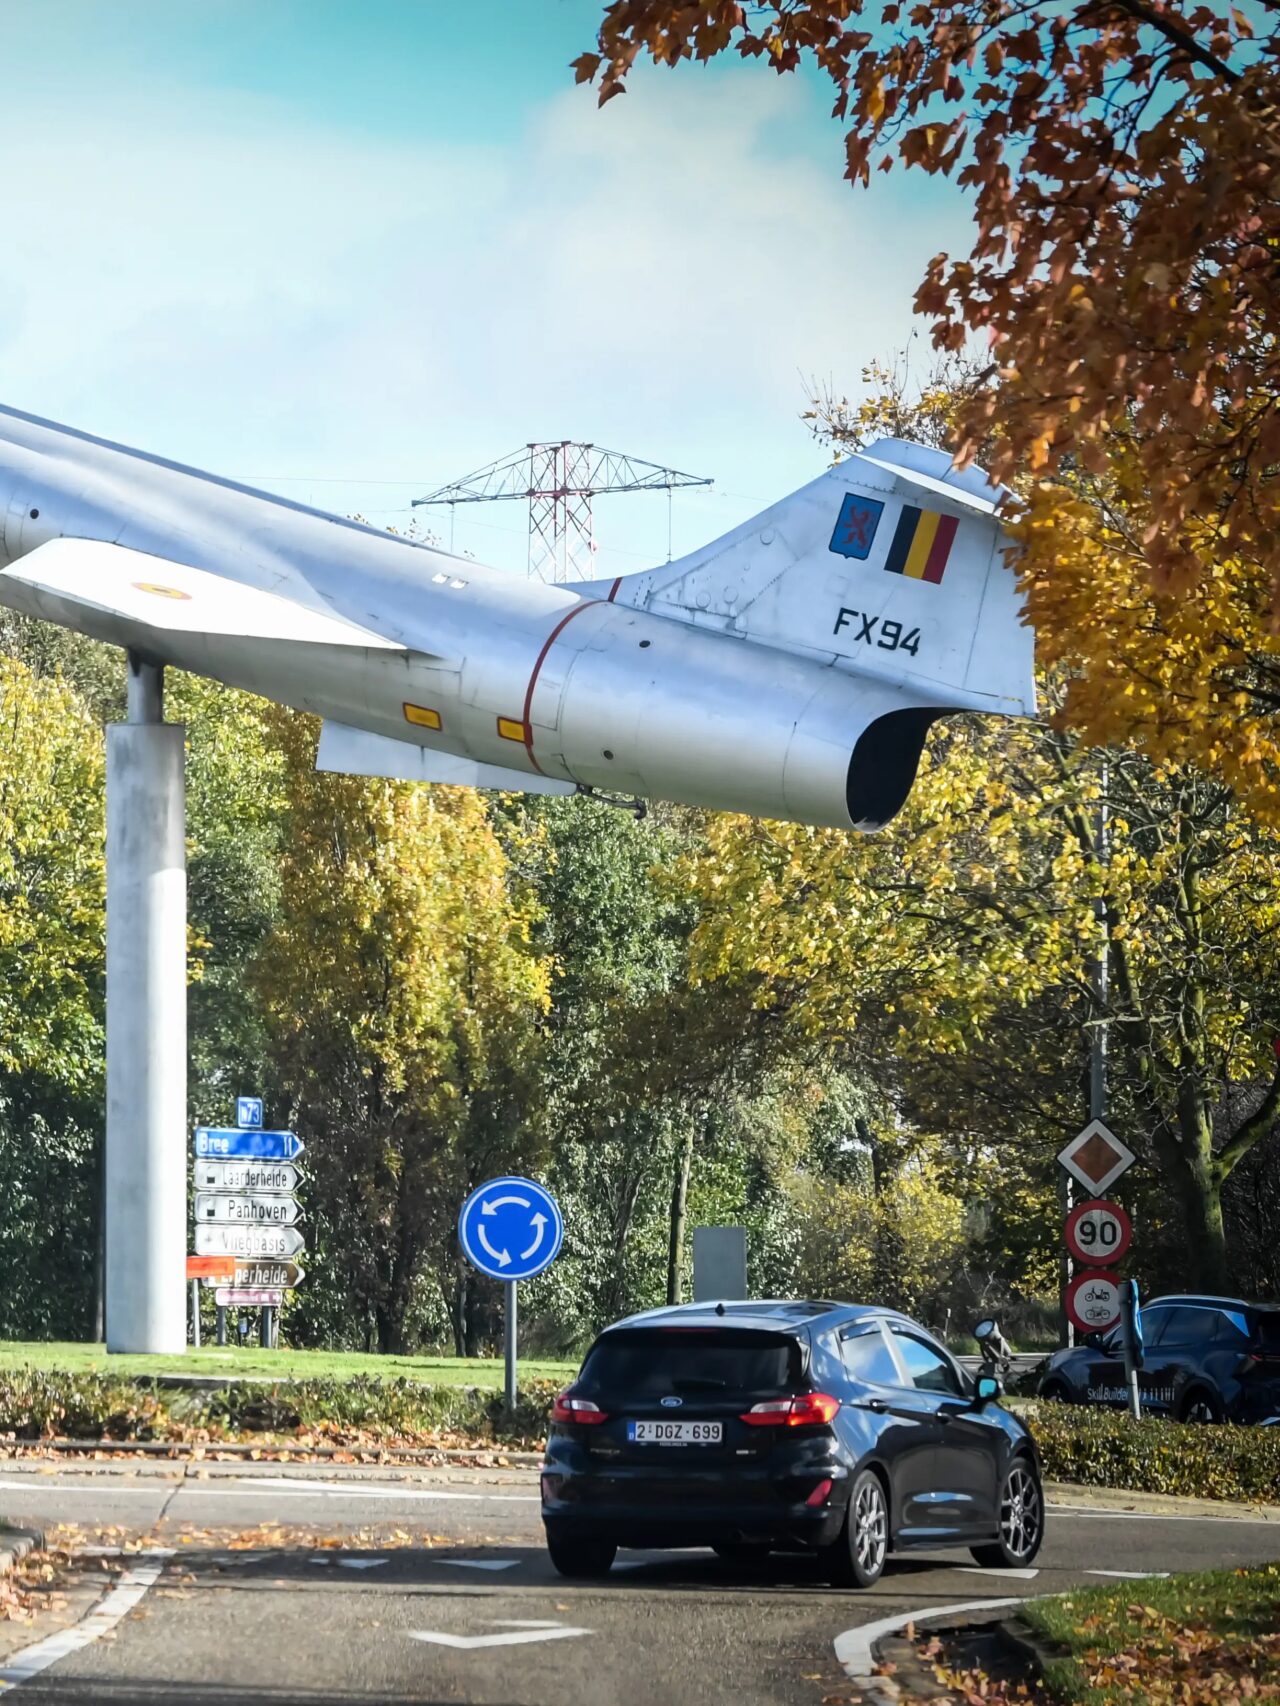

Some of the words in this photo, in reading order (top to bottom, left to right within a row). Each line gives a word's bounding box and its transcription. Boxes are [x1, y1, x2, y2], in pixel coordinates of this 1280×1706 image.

[832, 607, 921, 657] FX94
[199, 1132, 229, 1153] Bree
[223, 1164, 287, 1188] Laarderheide
[228, 1199, 287, 1220] Panhoven
[222, 1230, 286, 1256] Vliegbasis
[1078, 1220, 1118, 1246] 90
